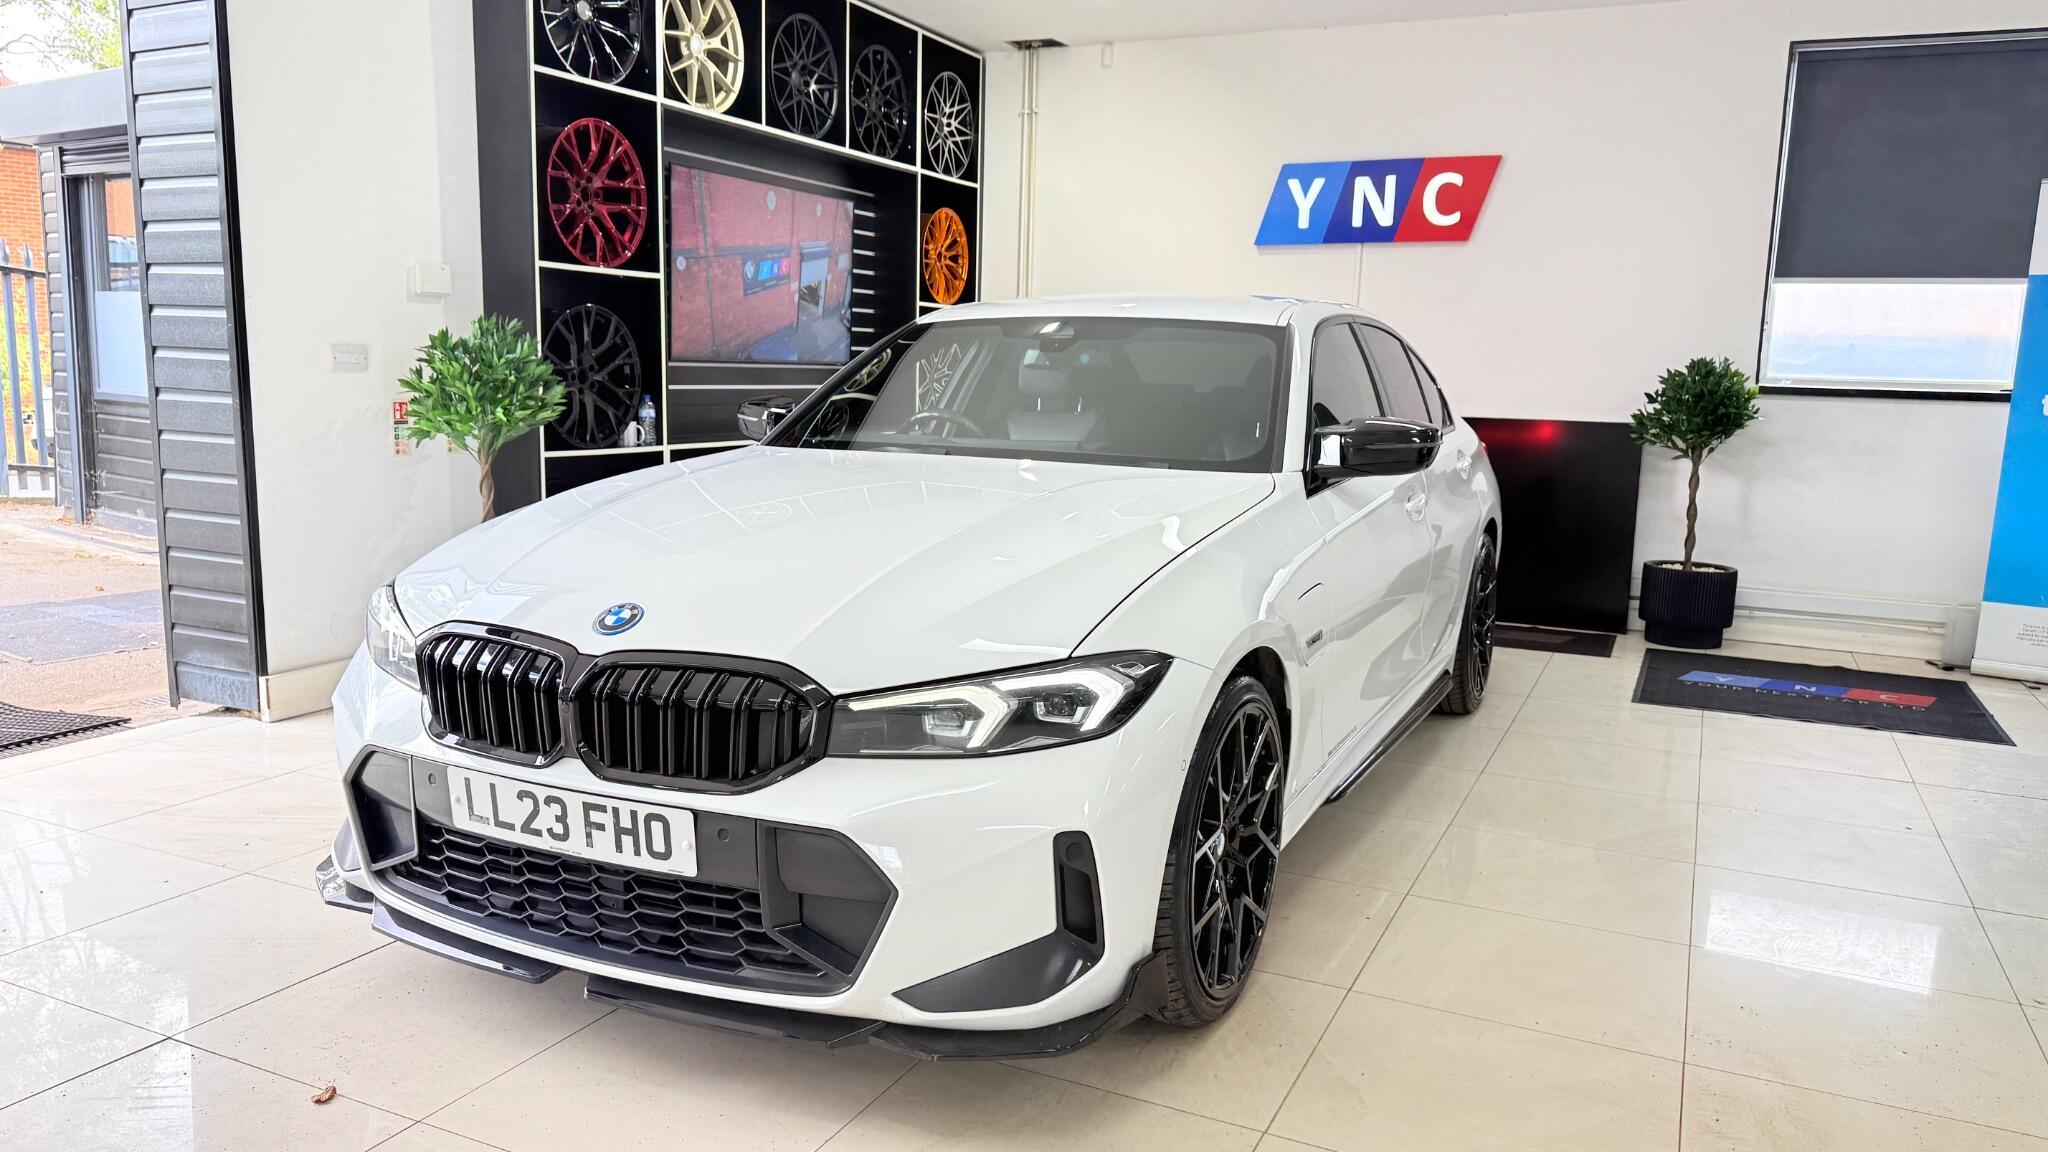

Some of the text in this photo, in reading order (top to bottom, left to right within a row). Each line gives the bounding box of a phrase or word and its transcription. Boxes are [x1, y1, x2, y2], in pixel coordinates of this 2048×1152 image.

[1287, 171, 1464, 229] YNC
[1684, 681, 1742, 690] YOUR
[1755, 688, 1813, 698] NEXT
[1824, 696, 1869, 705] CAR
[464, 777, 673, 861] LL23 FHO
